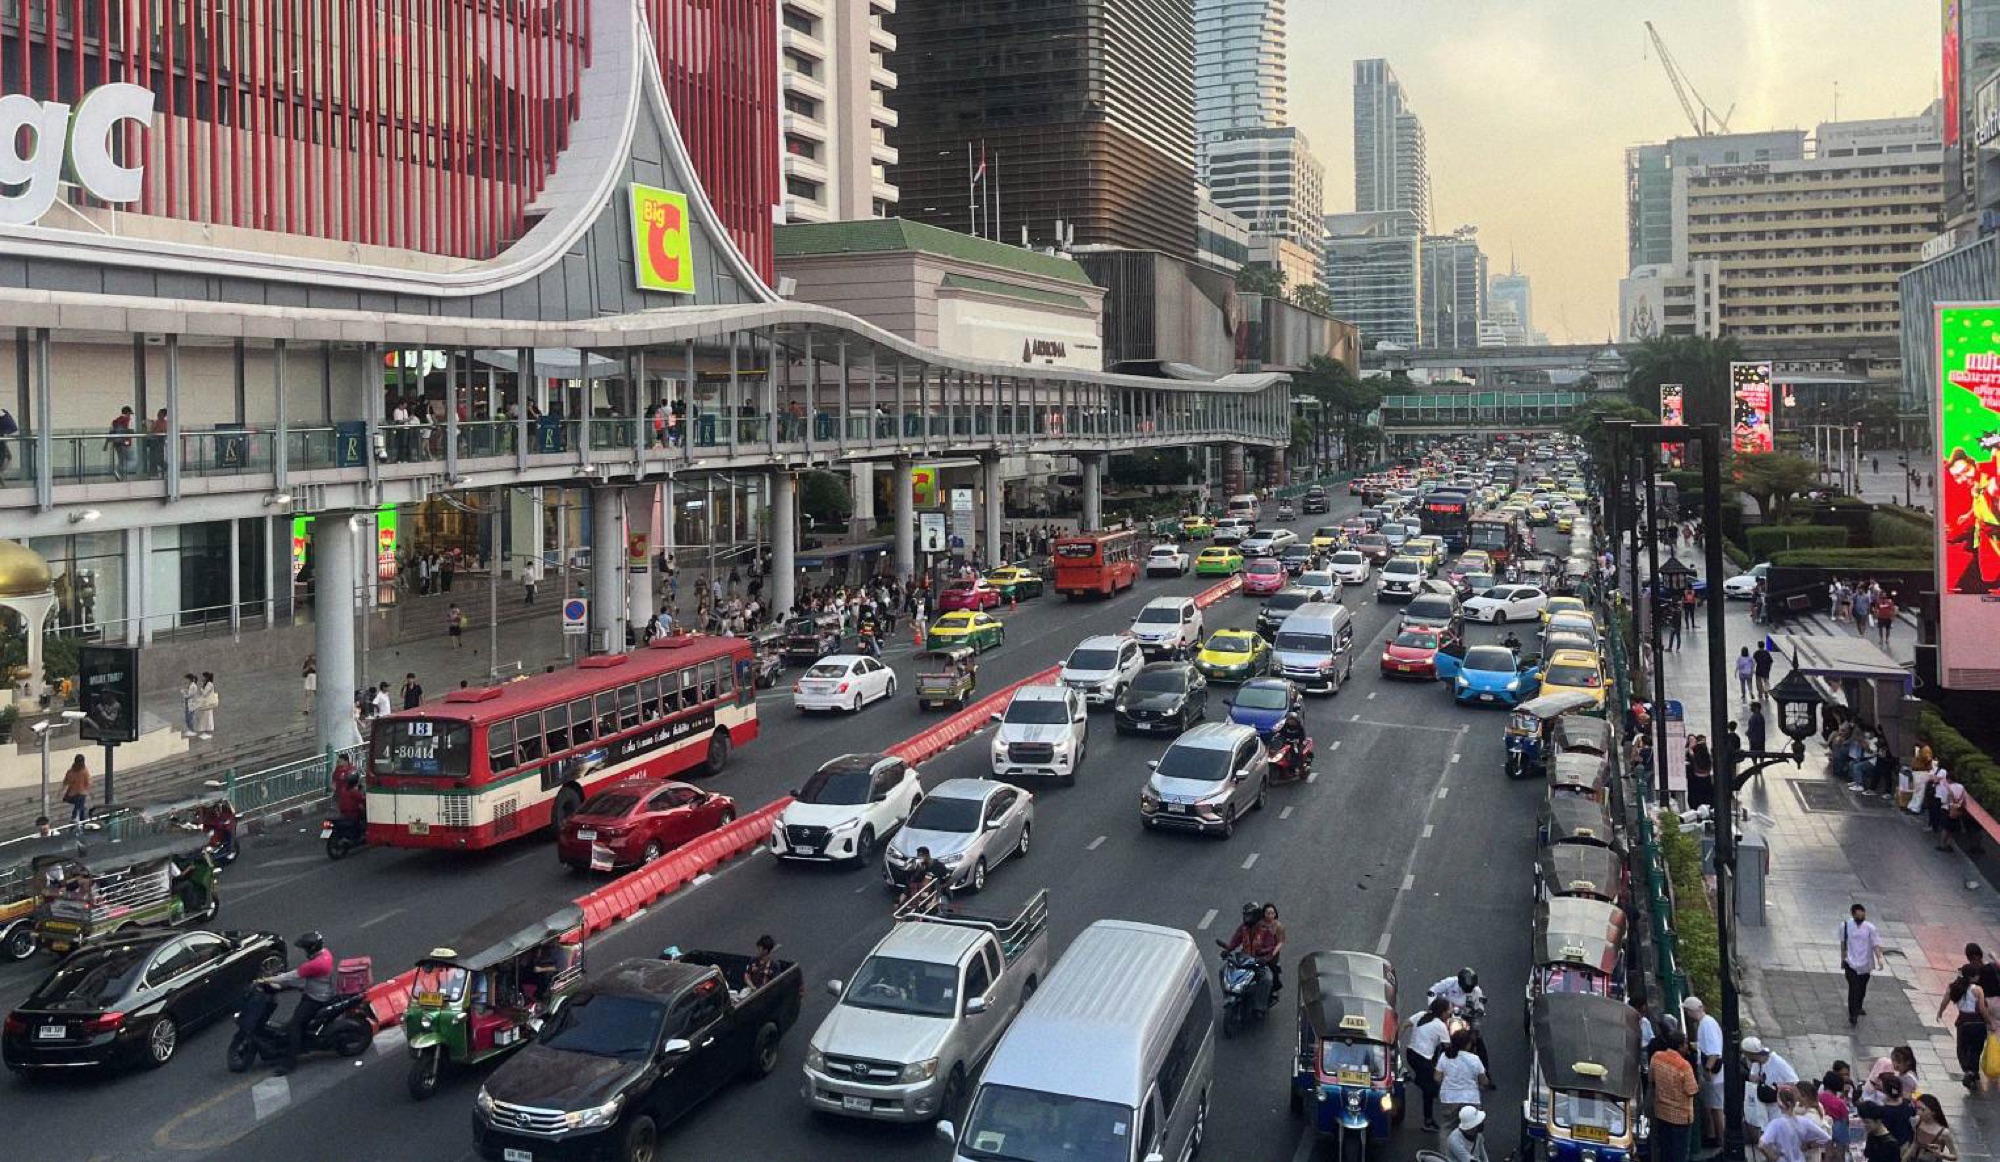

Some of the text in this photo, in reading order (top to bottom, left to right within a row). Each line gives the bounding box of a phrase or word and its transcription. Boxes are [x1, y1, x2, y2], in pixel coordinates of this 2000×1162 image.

[643, 199, 665, 228] Big
[648, 203, 680, 283] C
[412, 723, 429, 735] 13
[1345, 1017, 1366, 1027] TAXI
